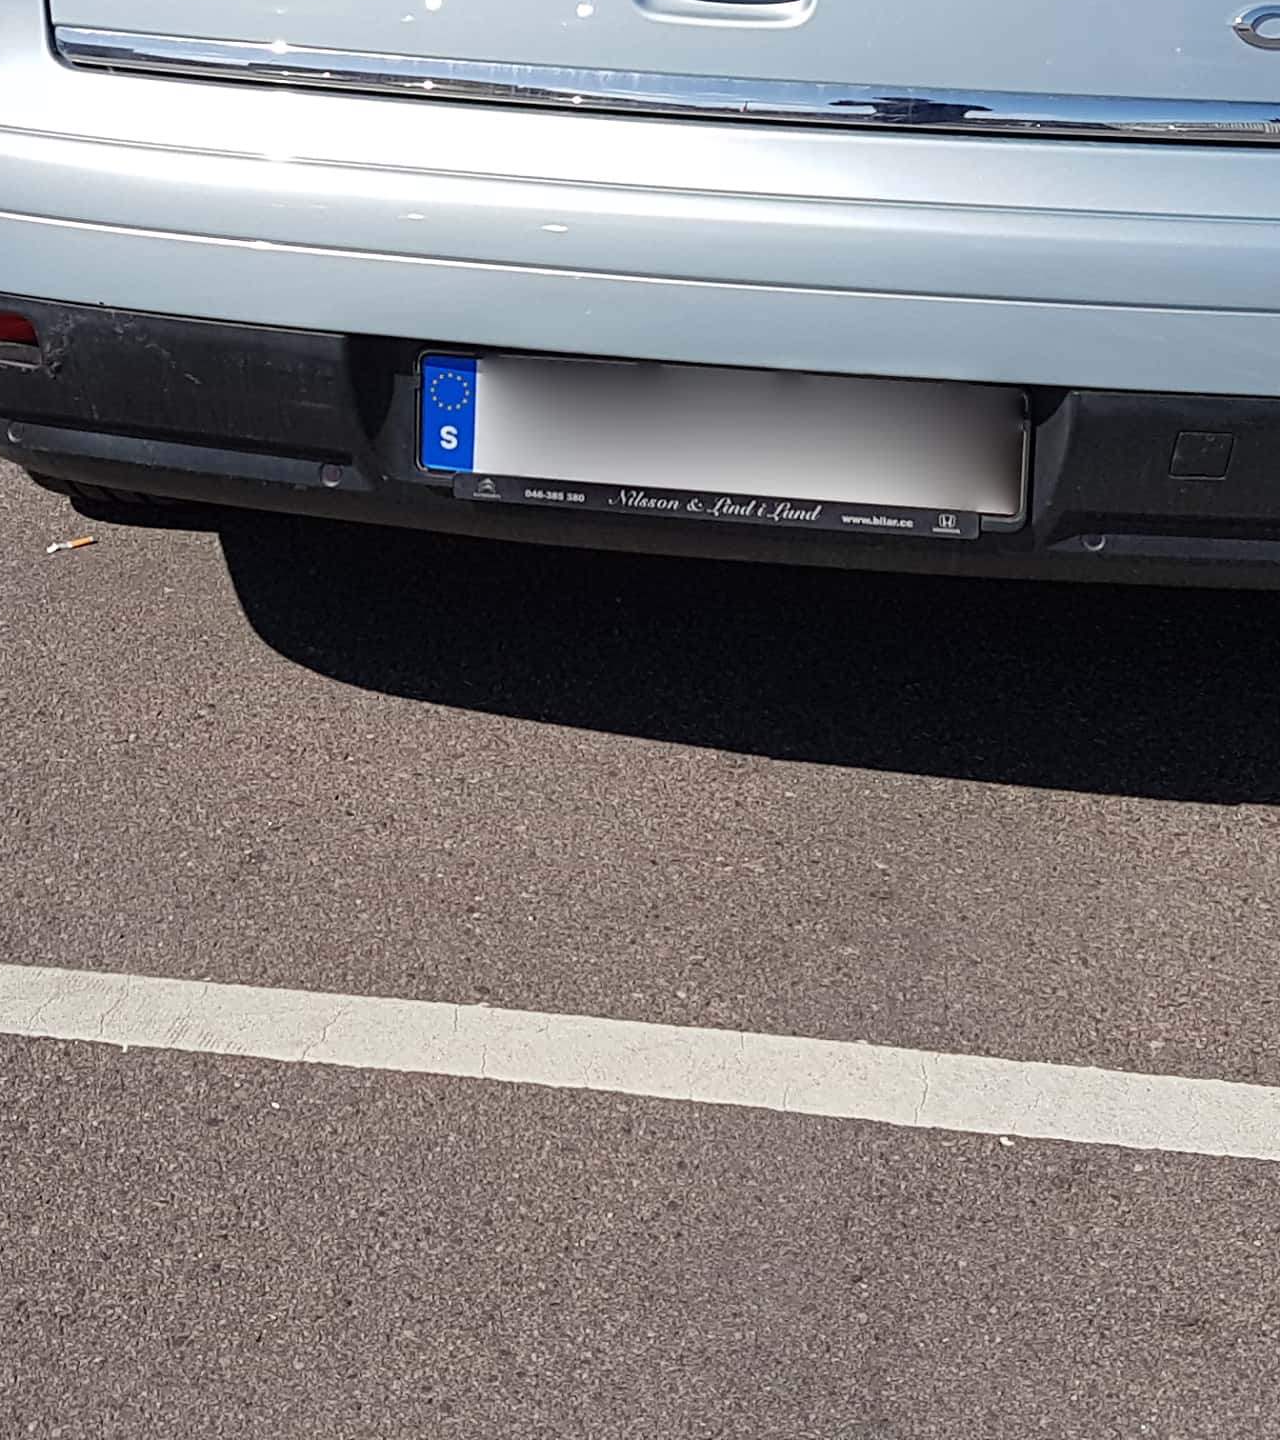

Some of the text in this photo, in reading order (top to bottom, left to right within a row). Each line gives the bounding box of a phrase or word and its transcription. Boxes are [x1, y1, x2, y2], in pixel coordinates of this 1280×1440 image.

[439, 425, 459, 451] S
[608, 489, 679, 511] Nilsson
[686, 496, 704, 511] &
[706, 496, 757, 517] Lind
[766, 500, 823, 522] Lund
